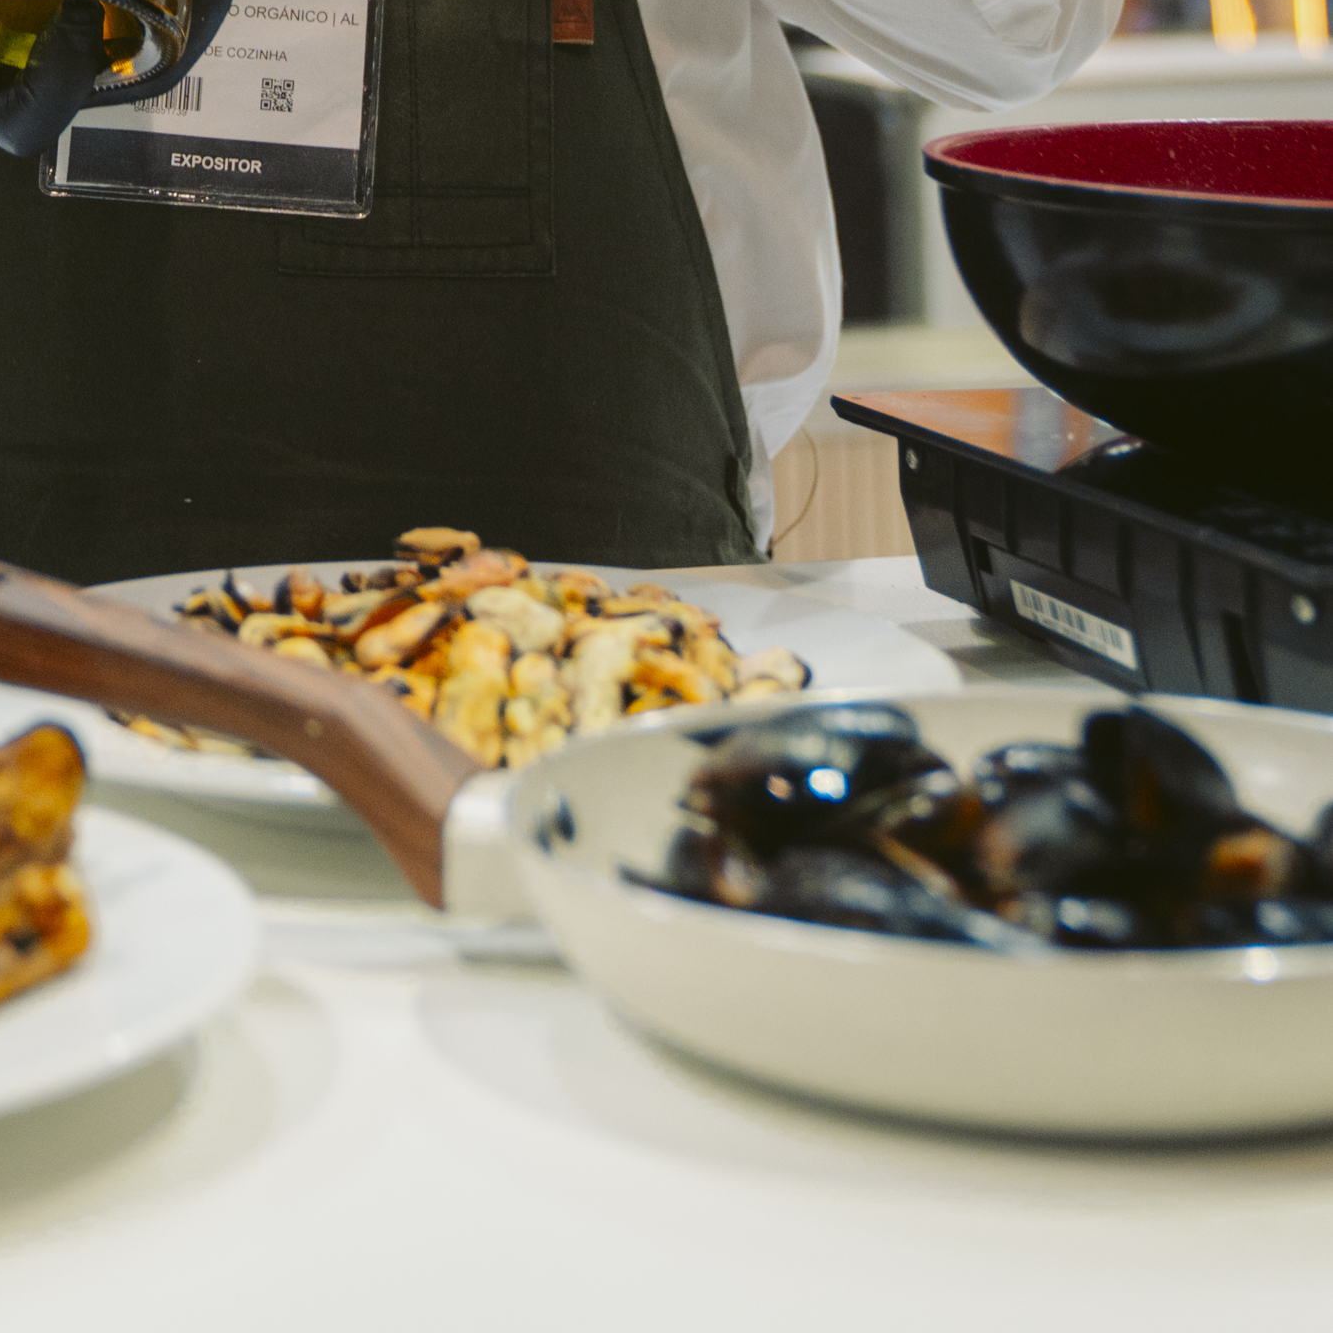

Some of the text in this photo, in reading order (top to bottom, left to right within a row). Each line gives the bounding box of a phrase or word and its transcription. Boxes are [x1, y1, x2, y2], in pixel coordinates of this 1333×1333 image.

[244, 5, 328, 23] ORGÁNICO
[340, 13, 359, 26] AL
[226, 47, 288, 62] COZINHA
[171, 153, 262, 173] EXPOSITOR
